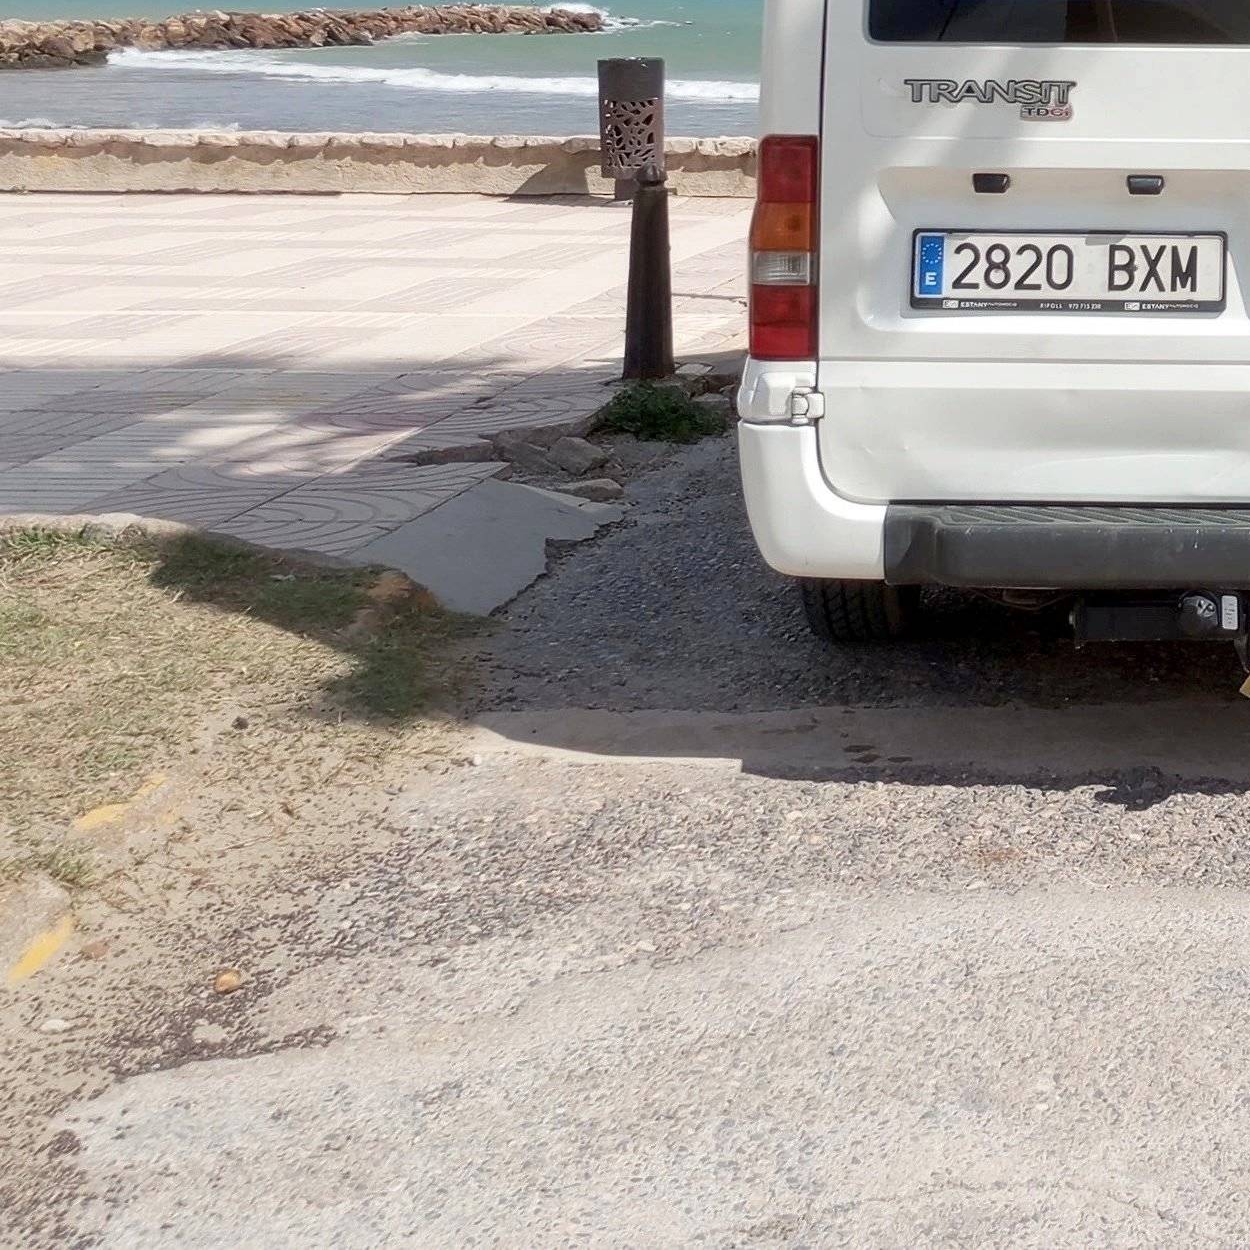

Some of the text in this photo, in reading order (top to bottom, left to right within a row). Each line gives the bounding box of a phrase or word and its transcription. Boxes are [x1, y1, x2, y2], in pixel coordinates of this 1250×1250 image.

[904, 79, 1077, 105] TRANSIT
[925, 272, 937, 286] E
[951, 242, 1198, 293] 2820 BXM
